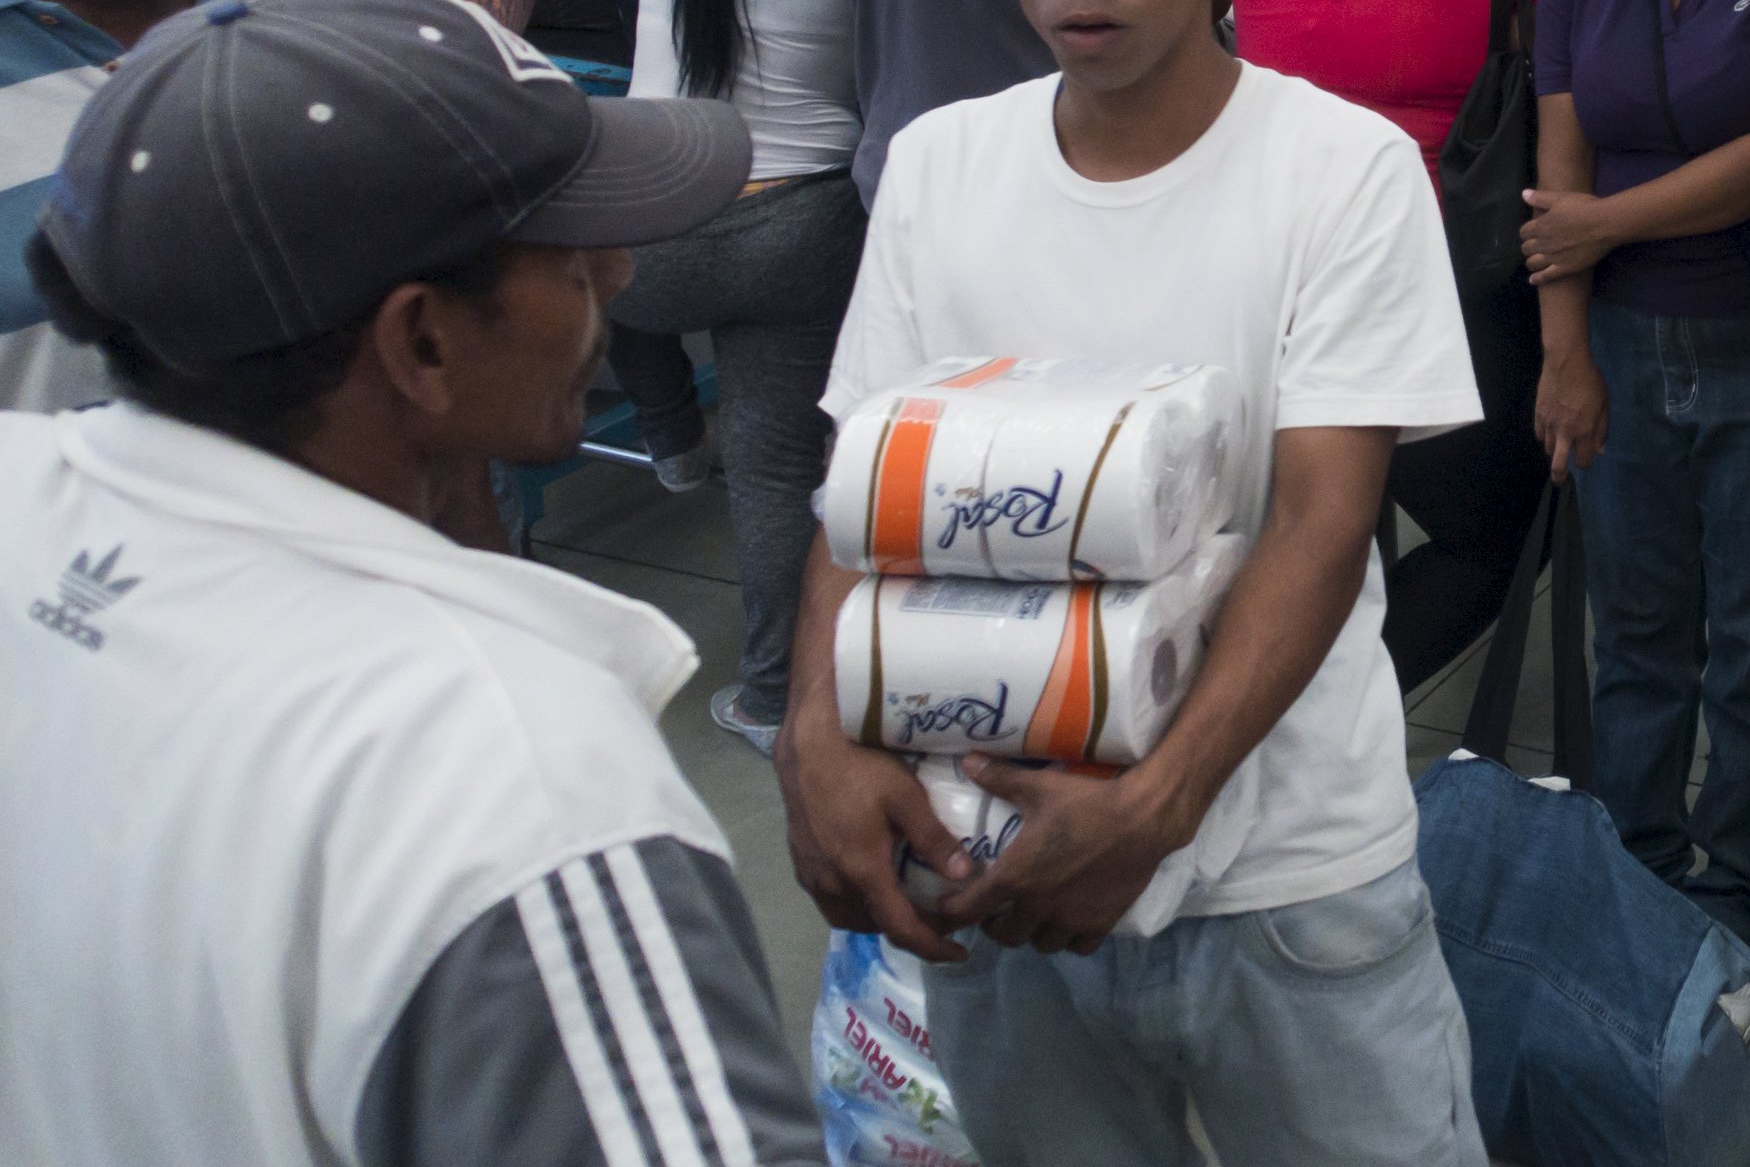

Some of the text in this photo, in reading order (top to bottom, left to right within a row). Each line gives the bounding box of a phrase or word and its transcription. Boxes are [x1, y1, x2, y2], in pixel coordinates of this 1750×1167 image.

[936, 468, 1070, 550] Rosal
[28, 598, 106, 652] adidas
[896, 680, 1020, 745] Rosal
[844, 1006, 908, 1091] ARIEL
